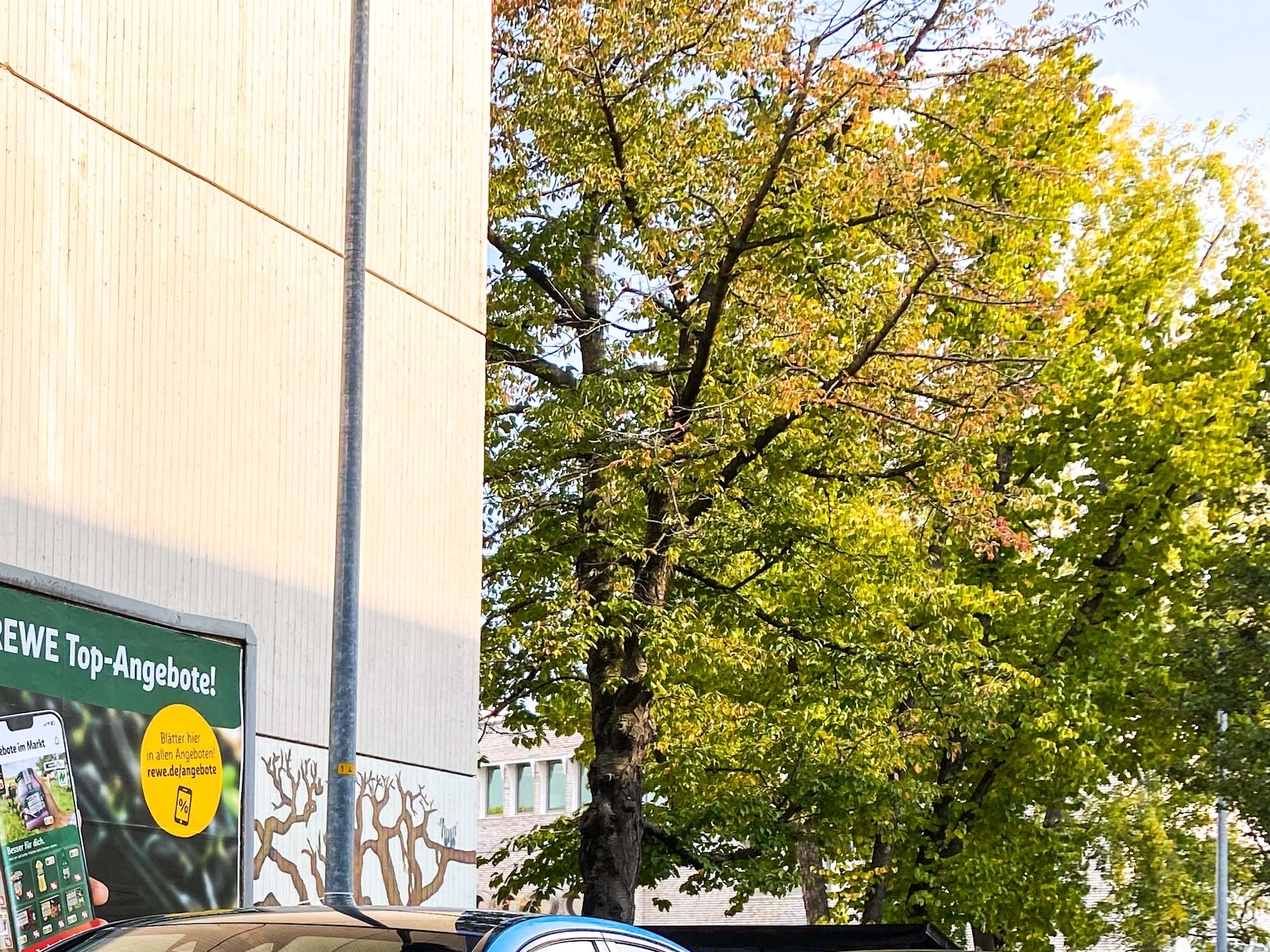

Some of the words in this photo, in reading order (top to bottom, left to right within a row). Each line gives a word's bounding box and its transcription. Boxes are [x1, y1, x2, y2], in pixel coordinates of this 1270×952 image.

[65, 633, 216, 696] Top-Angebote!
[160, 731, 185, 745] Blätter
[187, 732, 201, 744] hier
[17, 742, 26, 753] im
[27, 739, 46, 750] Markt
[146, 751, 154, 761] in
[156, 749, 173, 761] allen
[175, 748, 216, 763] Angeboten!
[147, 763, 217, 778] rewe.de/angebote
[6, 845, 24, 856] Besser
